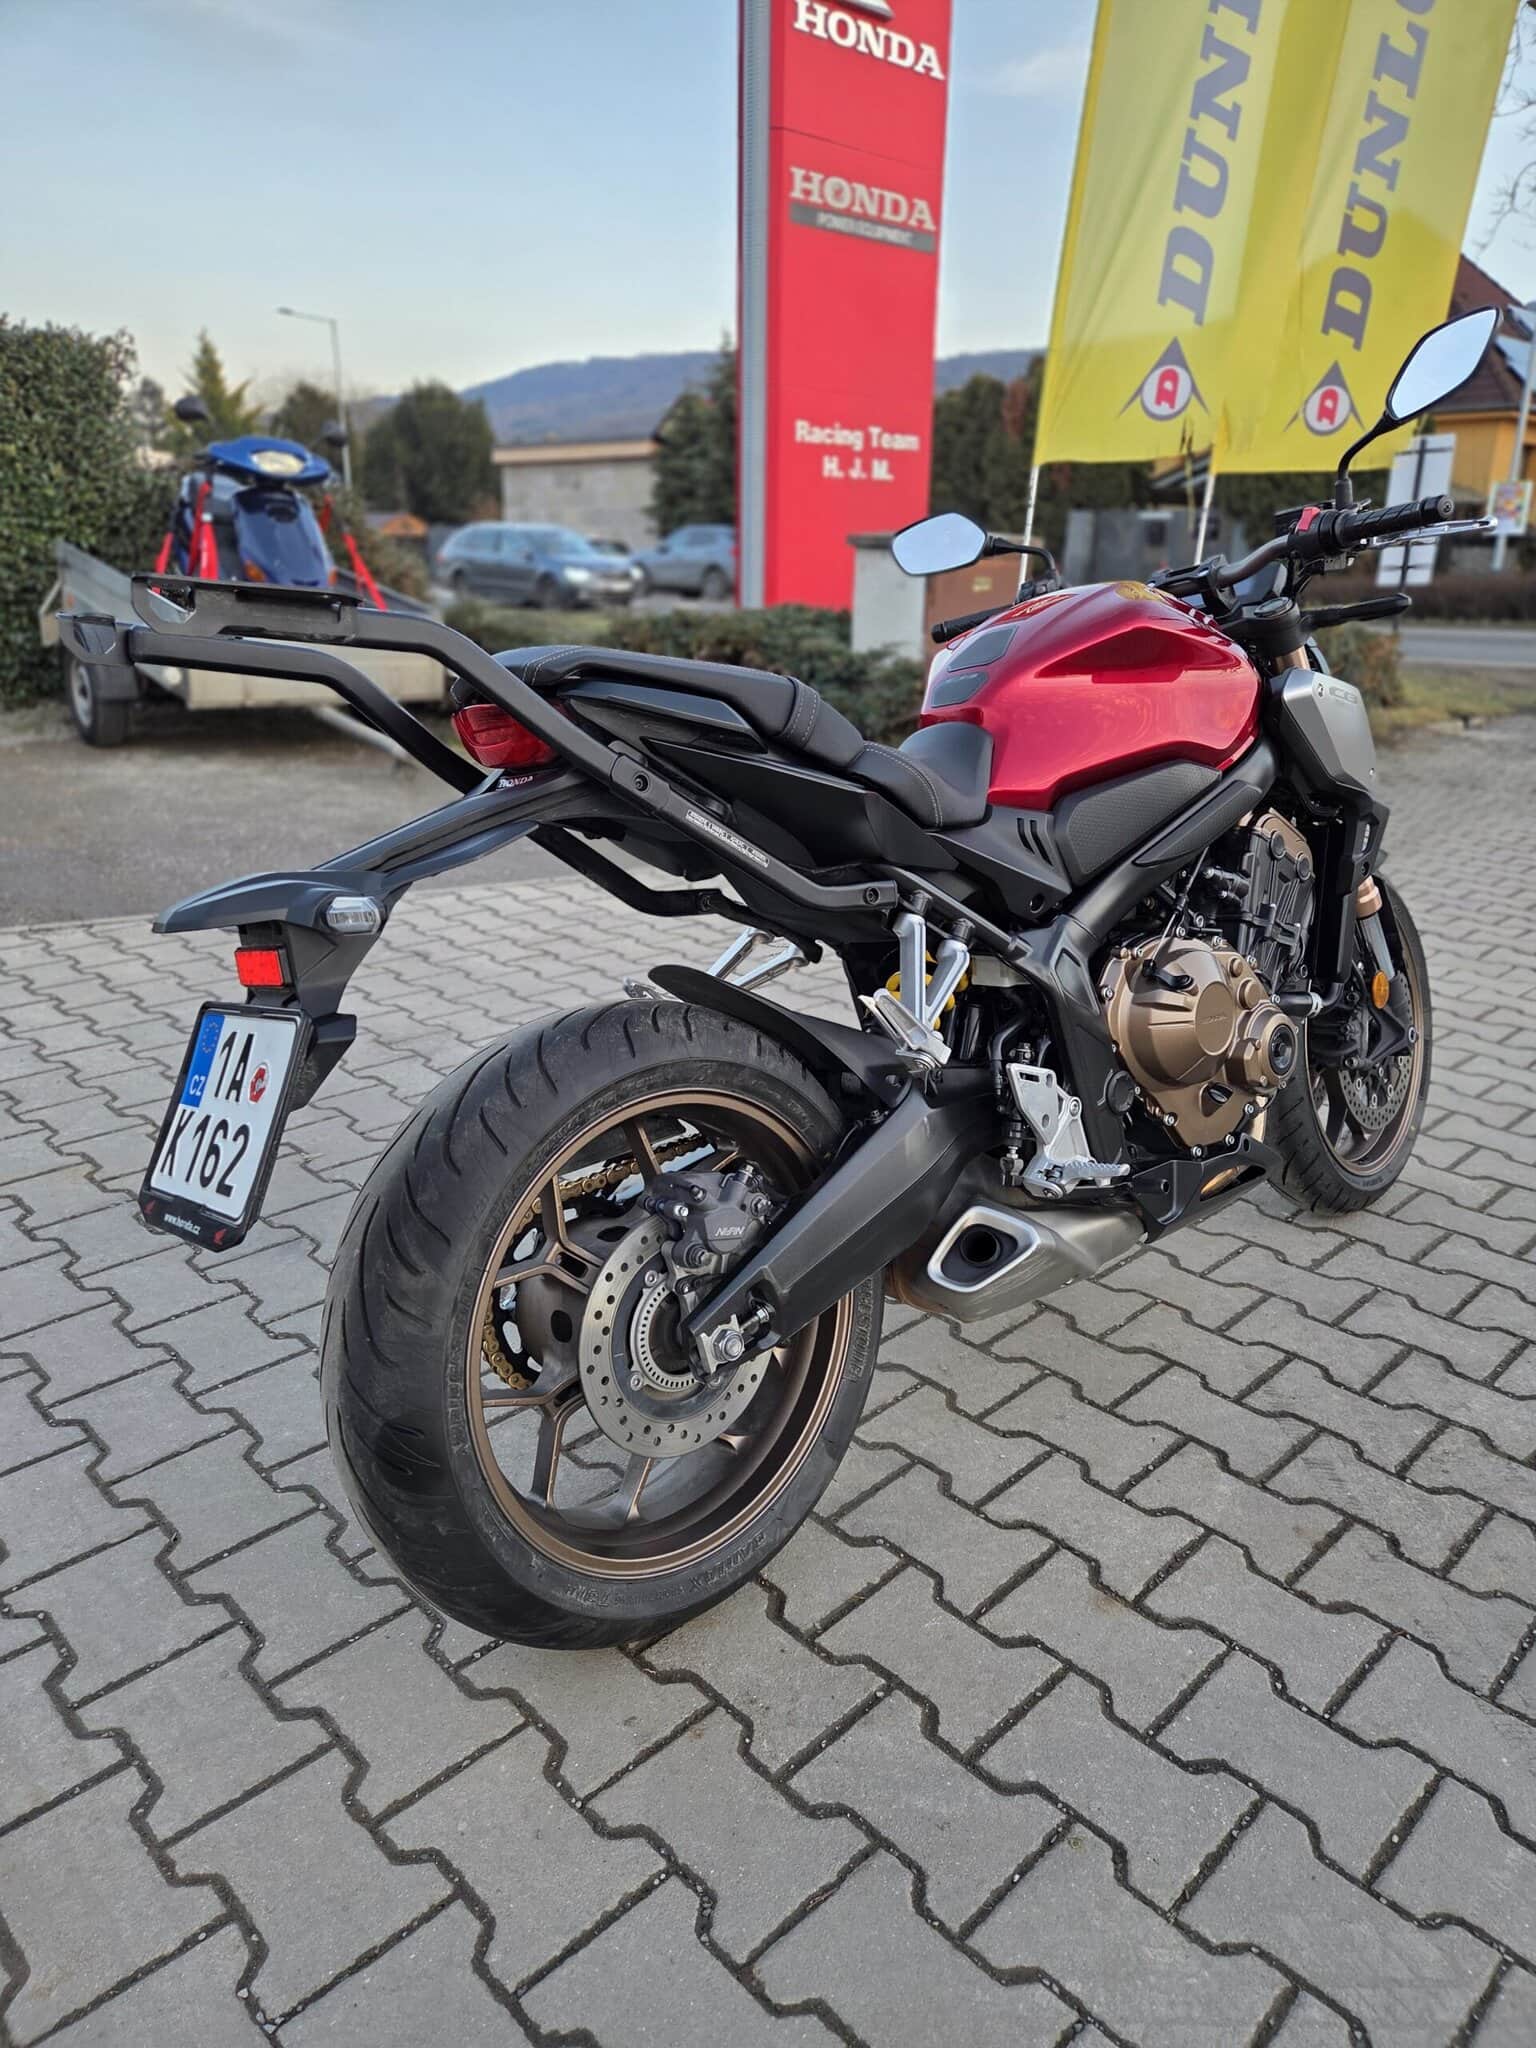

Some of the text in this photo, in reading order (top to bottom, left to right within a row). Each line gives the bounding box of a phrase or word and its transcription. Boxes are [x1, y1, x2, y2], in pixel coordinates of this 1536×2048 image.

[793, 0, 945, 80] HONDA
[789, 166, 937, 231] HONDA
[1320, 0, 1436, 352] DUNL
[794, 419, 920, 452] Racing Team
[188, 1074, 206, 1096] CZ
[214, 1031, 255, 1103] 1A
[159, 1108, 250, 1198] K162
